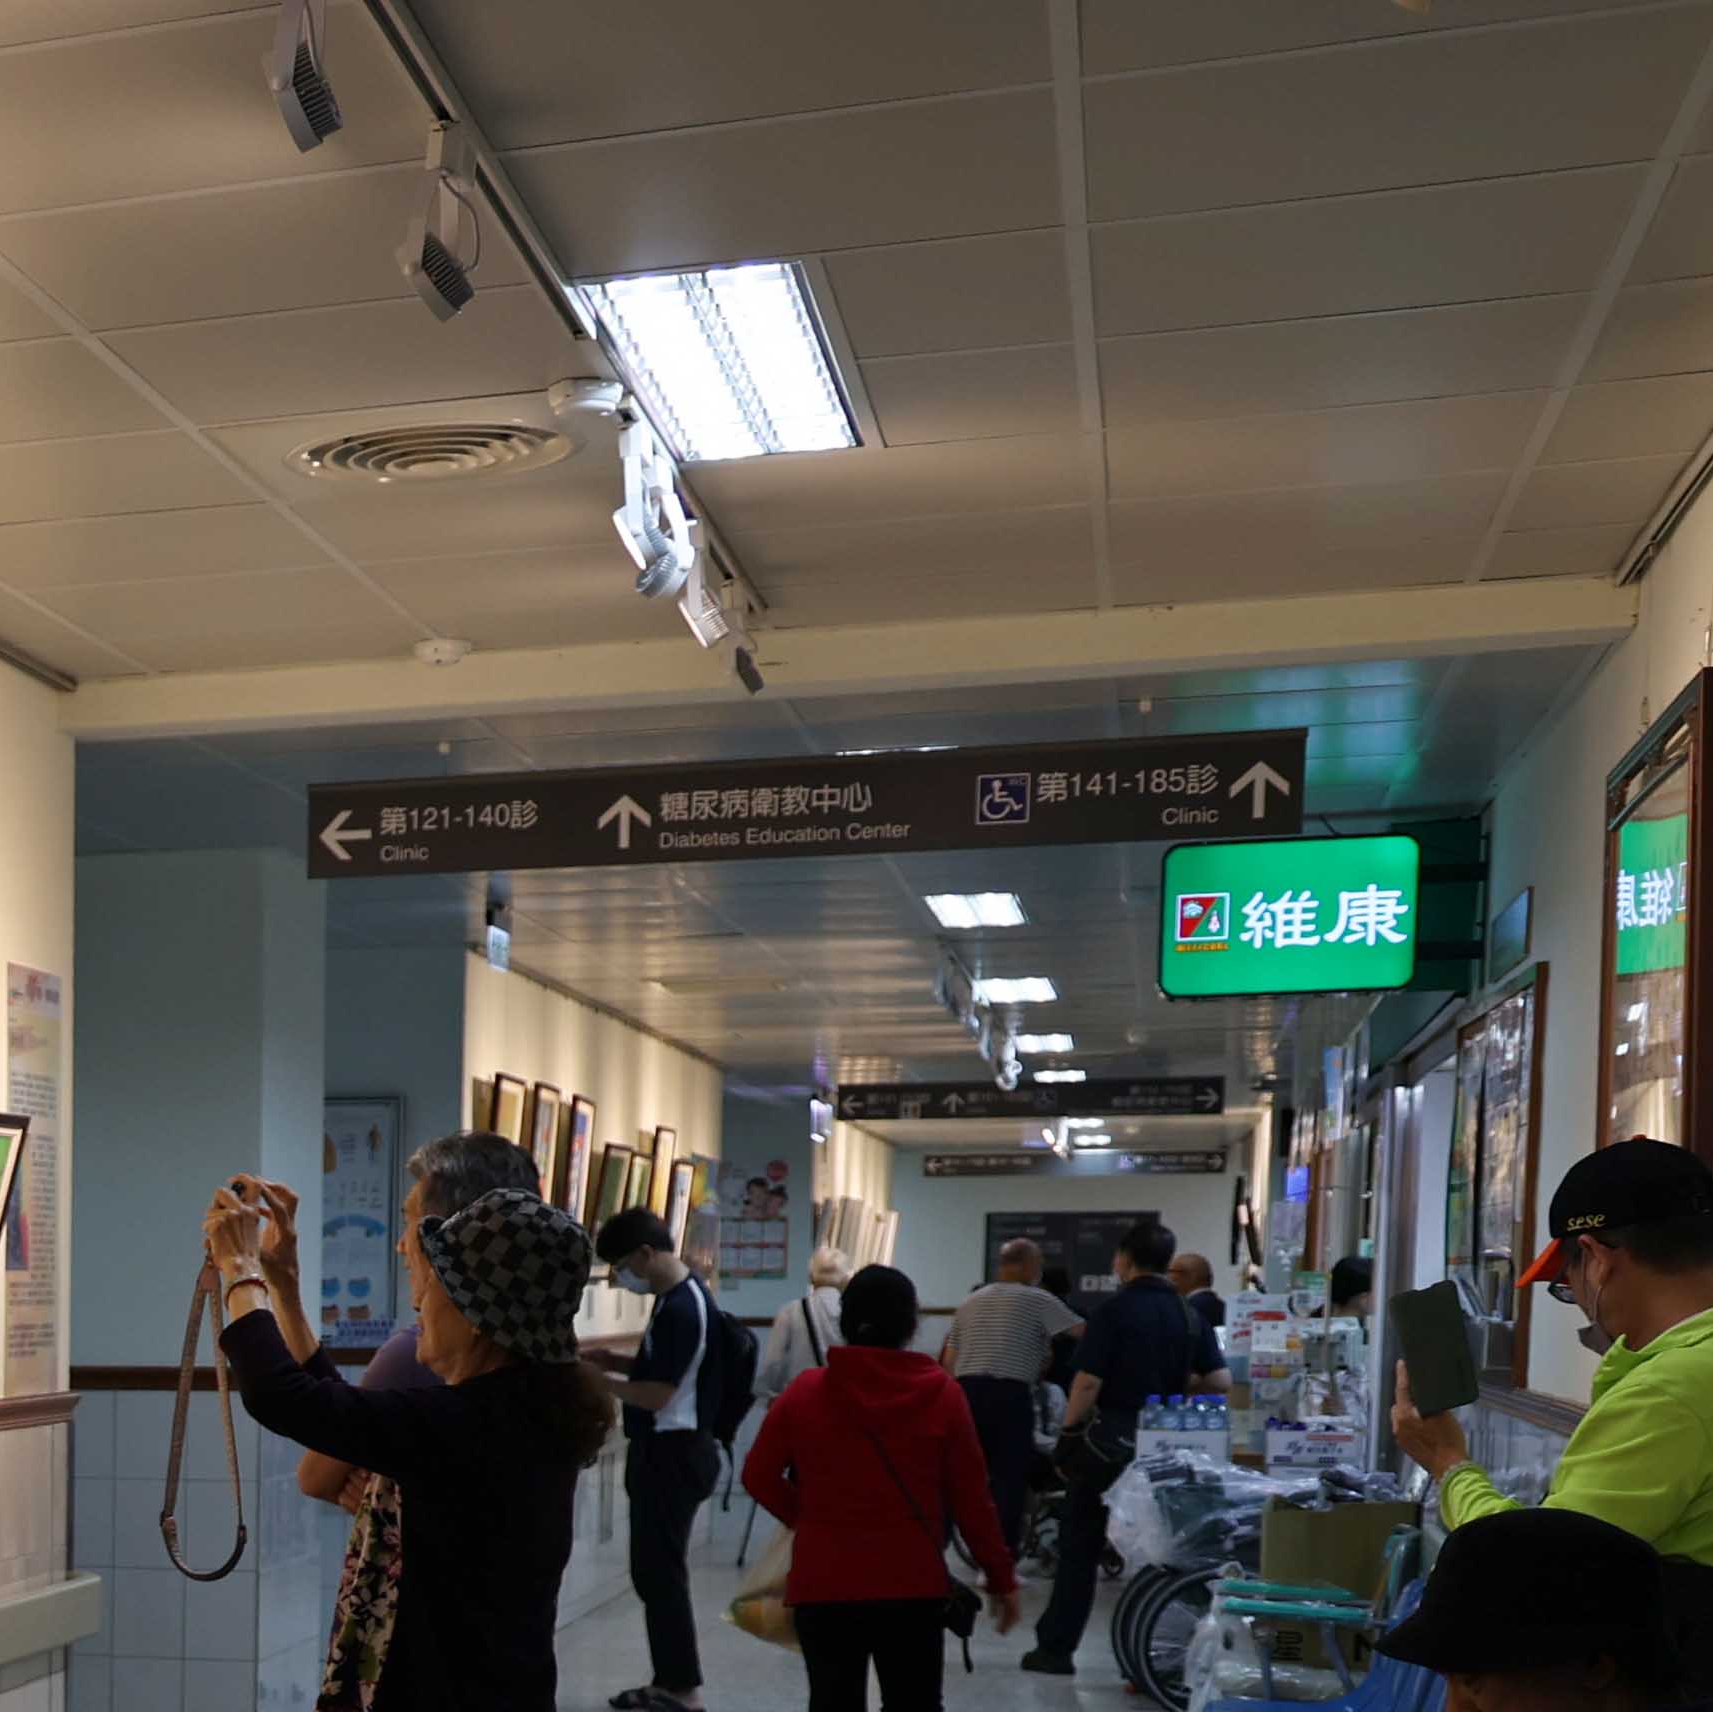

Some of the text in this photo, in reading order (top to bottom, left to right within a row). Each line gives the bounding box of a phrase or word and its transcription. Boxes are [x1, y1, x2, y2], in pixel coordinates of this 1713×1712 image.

[1036, 763, 1219, 802] 第141-185診
[379, 799, 539, 835] 第121-140診
[659, 781, 873, 822] 糖尿病衛教中心
[1161, 806, 1220, 825] Clinic
[659, 821, 911, 849] Diabetes Education Center
[379, 845, 430, 862] Clinic
[1239, 883, 1409, 949] 維康
